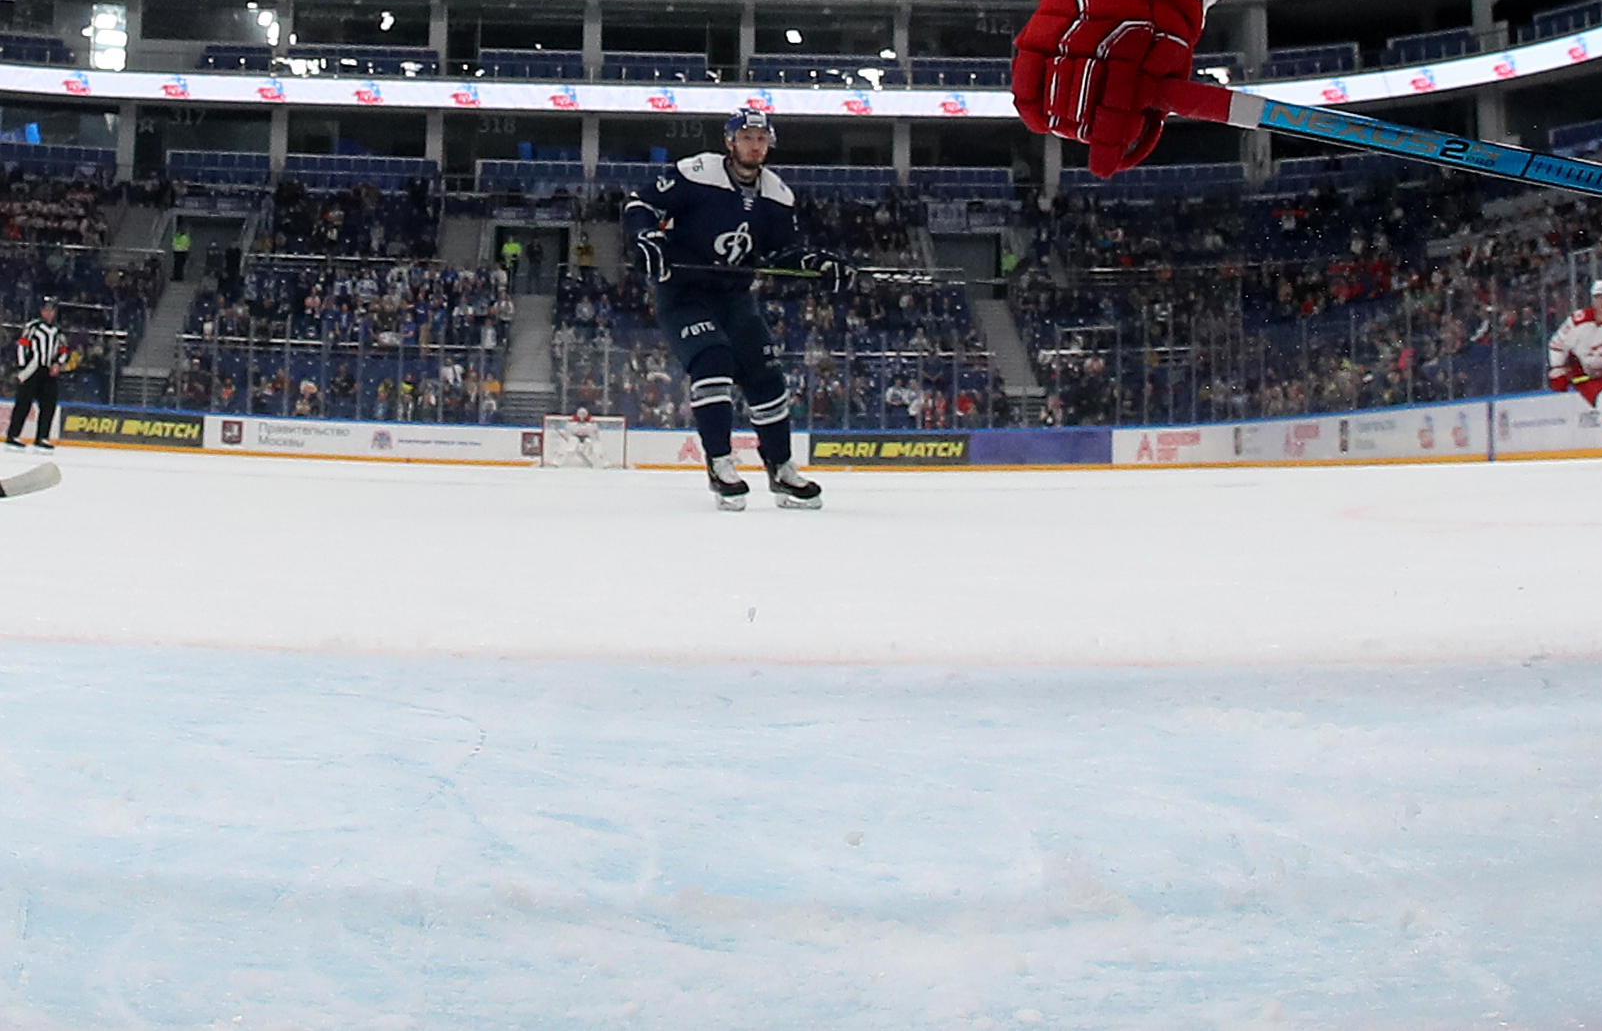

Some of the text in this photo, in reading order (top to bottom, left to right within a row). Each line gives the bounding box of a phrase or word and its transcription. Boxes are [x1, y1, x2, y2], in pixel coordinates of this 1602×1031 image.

[1267, 104, 1440, 154] NEXUS
[73, 416, 201, 440] PARI MATCH
[257, 420, 351, 440] Правительство
[257, 435, 306, 449] Москвы
[828, 440, 966, 458] PARI MATCH
